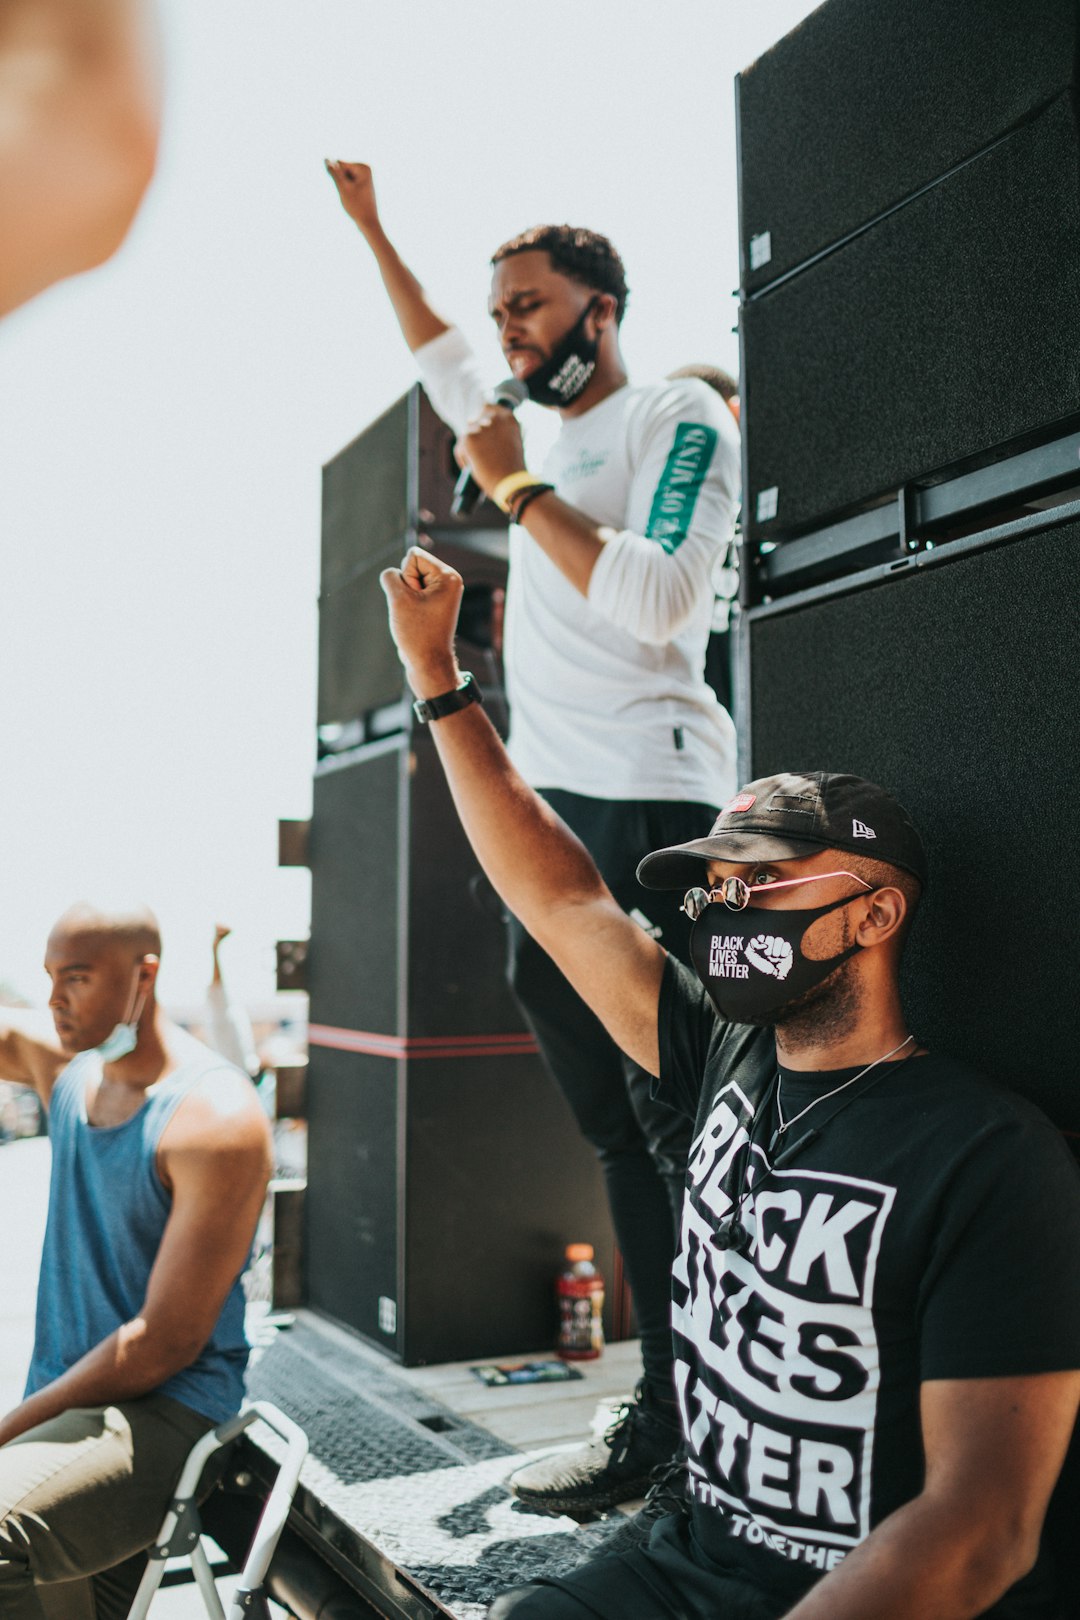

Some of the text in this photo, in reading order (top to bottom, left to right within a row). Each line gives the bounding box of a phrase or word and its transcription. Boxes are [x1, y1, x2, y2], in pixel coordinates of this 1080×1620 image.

[669, 428, 708, 485] MIND
[711, 935, 745, 951] BLACK
[709, 949, 738, 964] LIVES
[708, 962, 749, 979] MATTER
[730, 1514, 847, 1571] TOETHE
